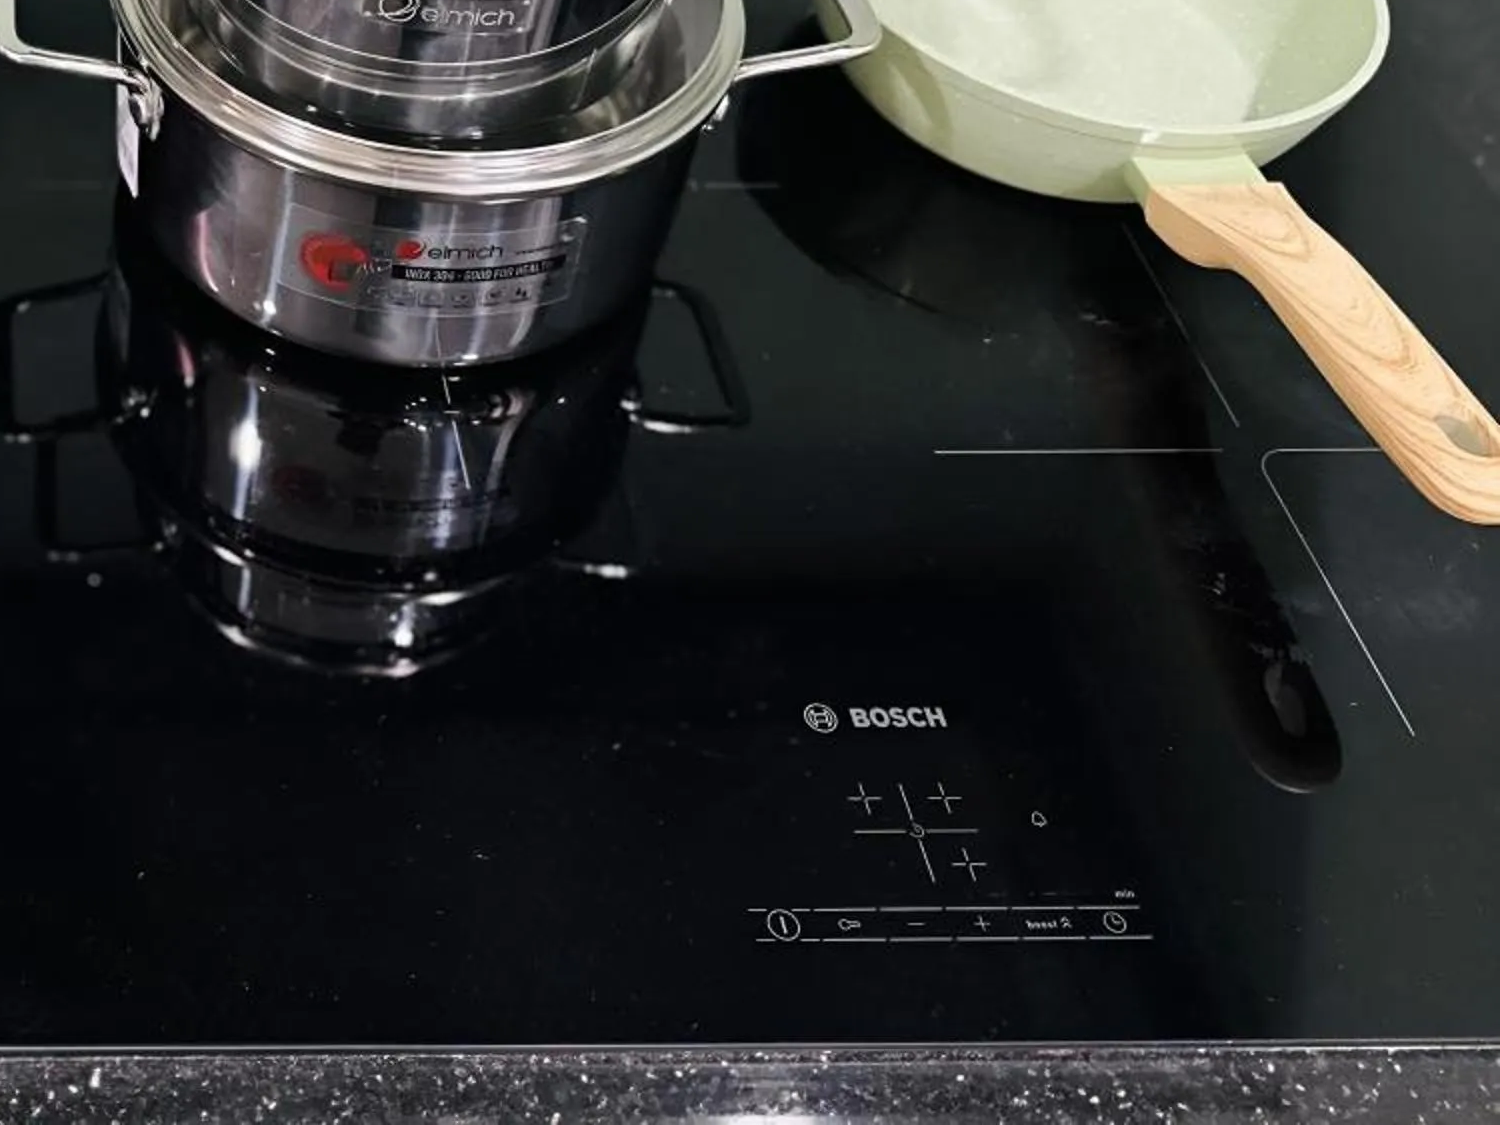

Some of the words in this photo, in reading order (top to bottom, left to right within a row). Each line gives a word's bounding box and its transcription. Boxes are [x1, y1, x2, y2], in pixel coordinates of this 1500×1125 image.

[421, 7, 515, 25] elmich
[427, 243, 504, 259] elmich
[849, 707, 948, 727] BOSCH
[1114, 888, 1135, 899] min
